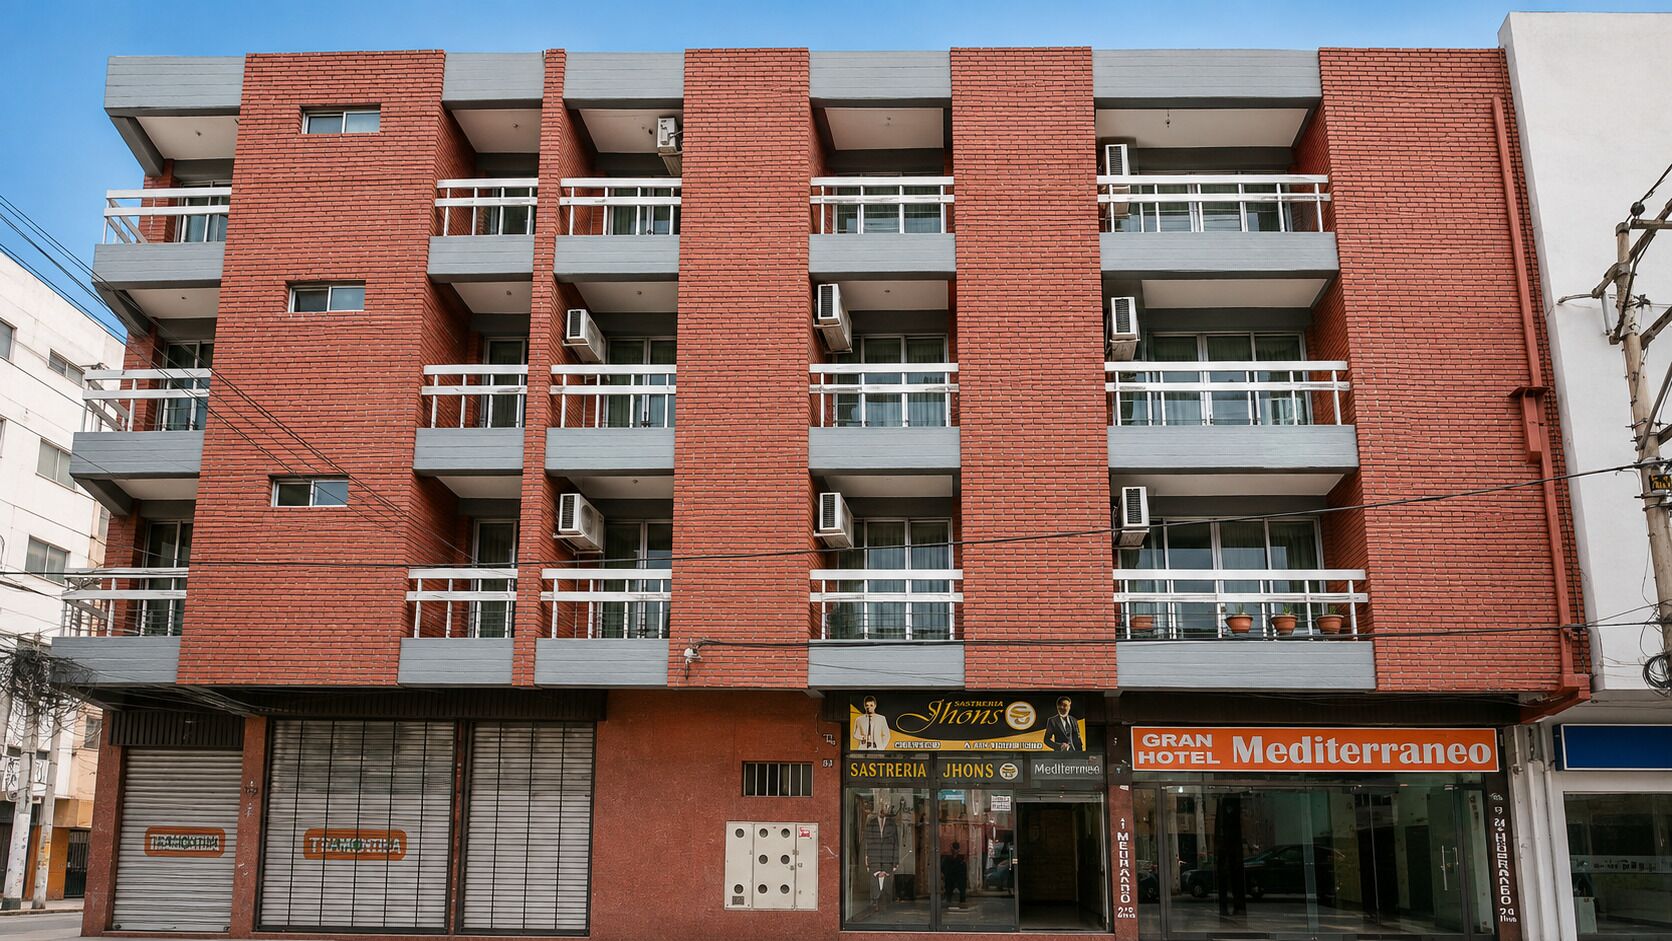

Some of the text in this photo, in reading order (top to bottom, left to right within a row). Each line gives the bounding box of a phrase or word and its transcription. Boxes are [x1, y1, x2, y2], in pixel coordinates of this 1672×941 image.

[954, 700, 1004, 708] SASTRERIA
[896, 699, 1005, 733] Jhons
[1142, 733, 1214, 748] GRAN
[1231, 735, 1493, 765] Mediterraneo
[1138, 751, 1221, 765] HOTEL
[850, 762, 927, 778] SASTRERIA
[942, 762, 994, 778] JHONS
